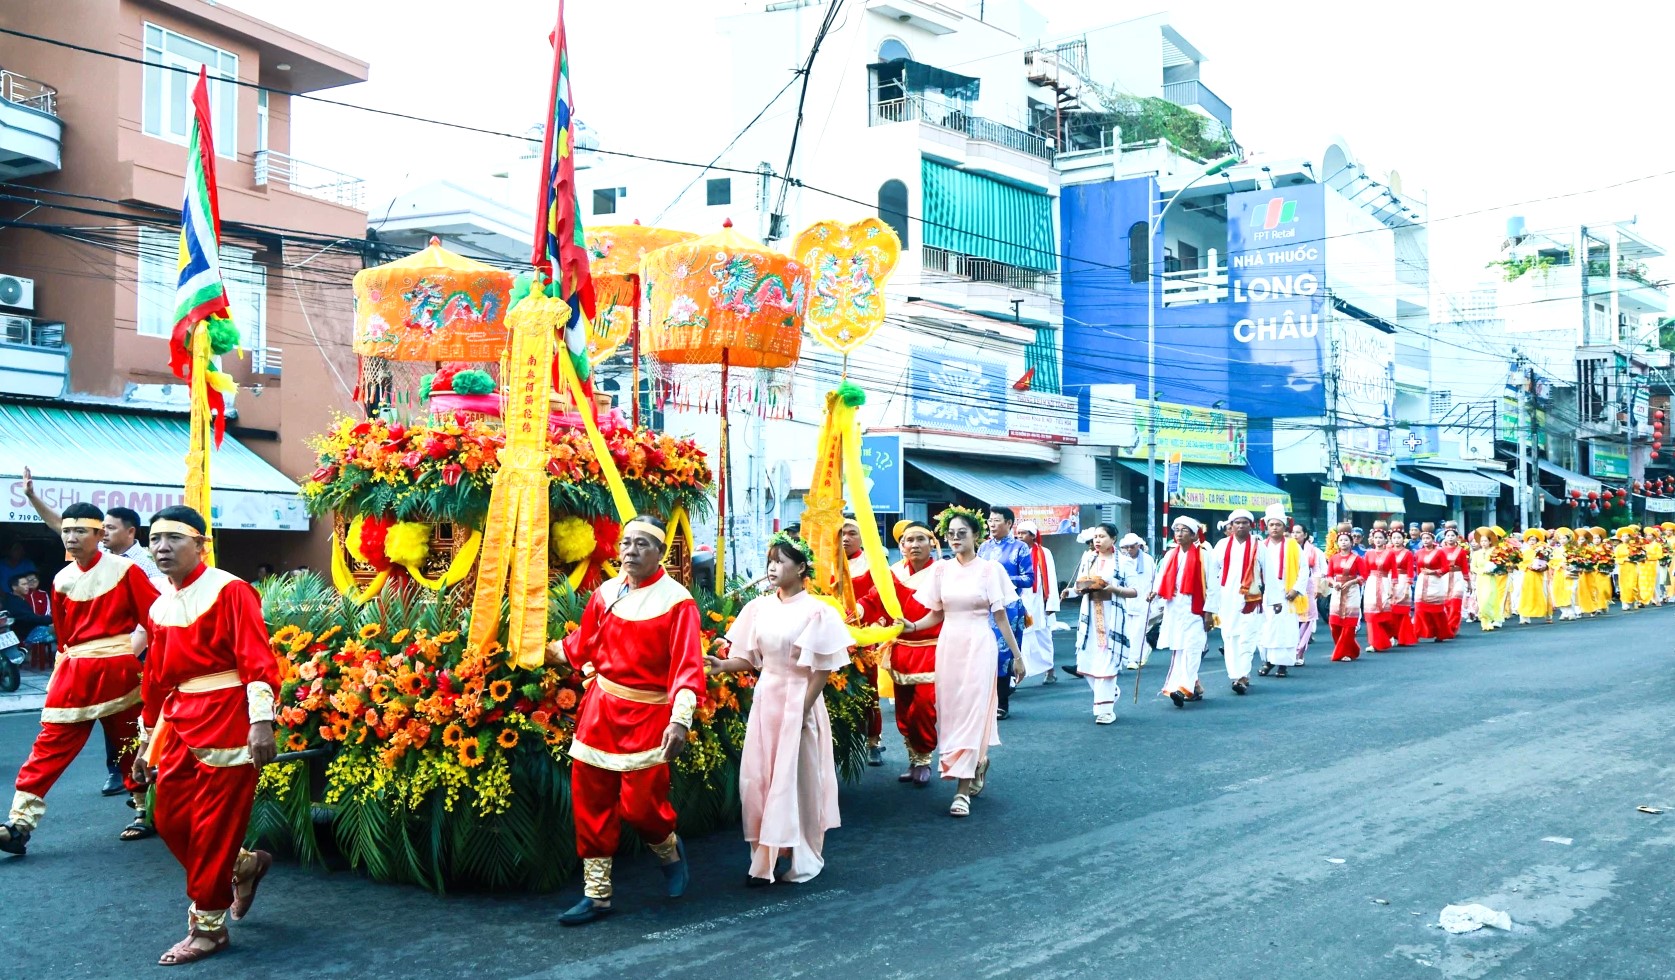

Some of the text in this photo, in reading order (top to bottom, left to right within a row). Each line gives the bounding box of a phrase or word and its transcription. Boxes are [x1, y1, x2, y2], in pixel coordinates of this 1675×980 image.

[1254, 228, 1295, 241] FPT Retail
[1233, 244, 1318, 268] NHÀ THUỐC
[1234, 273, 1318, 303] LONG
[1233, 309, 1319, 343] CHÂU
